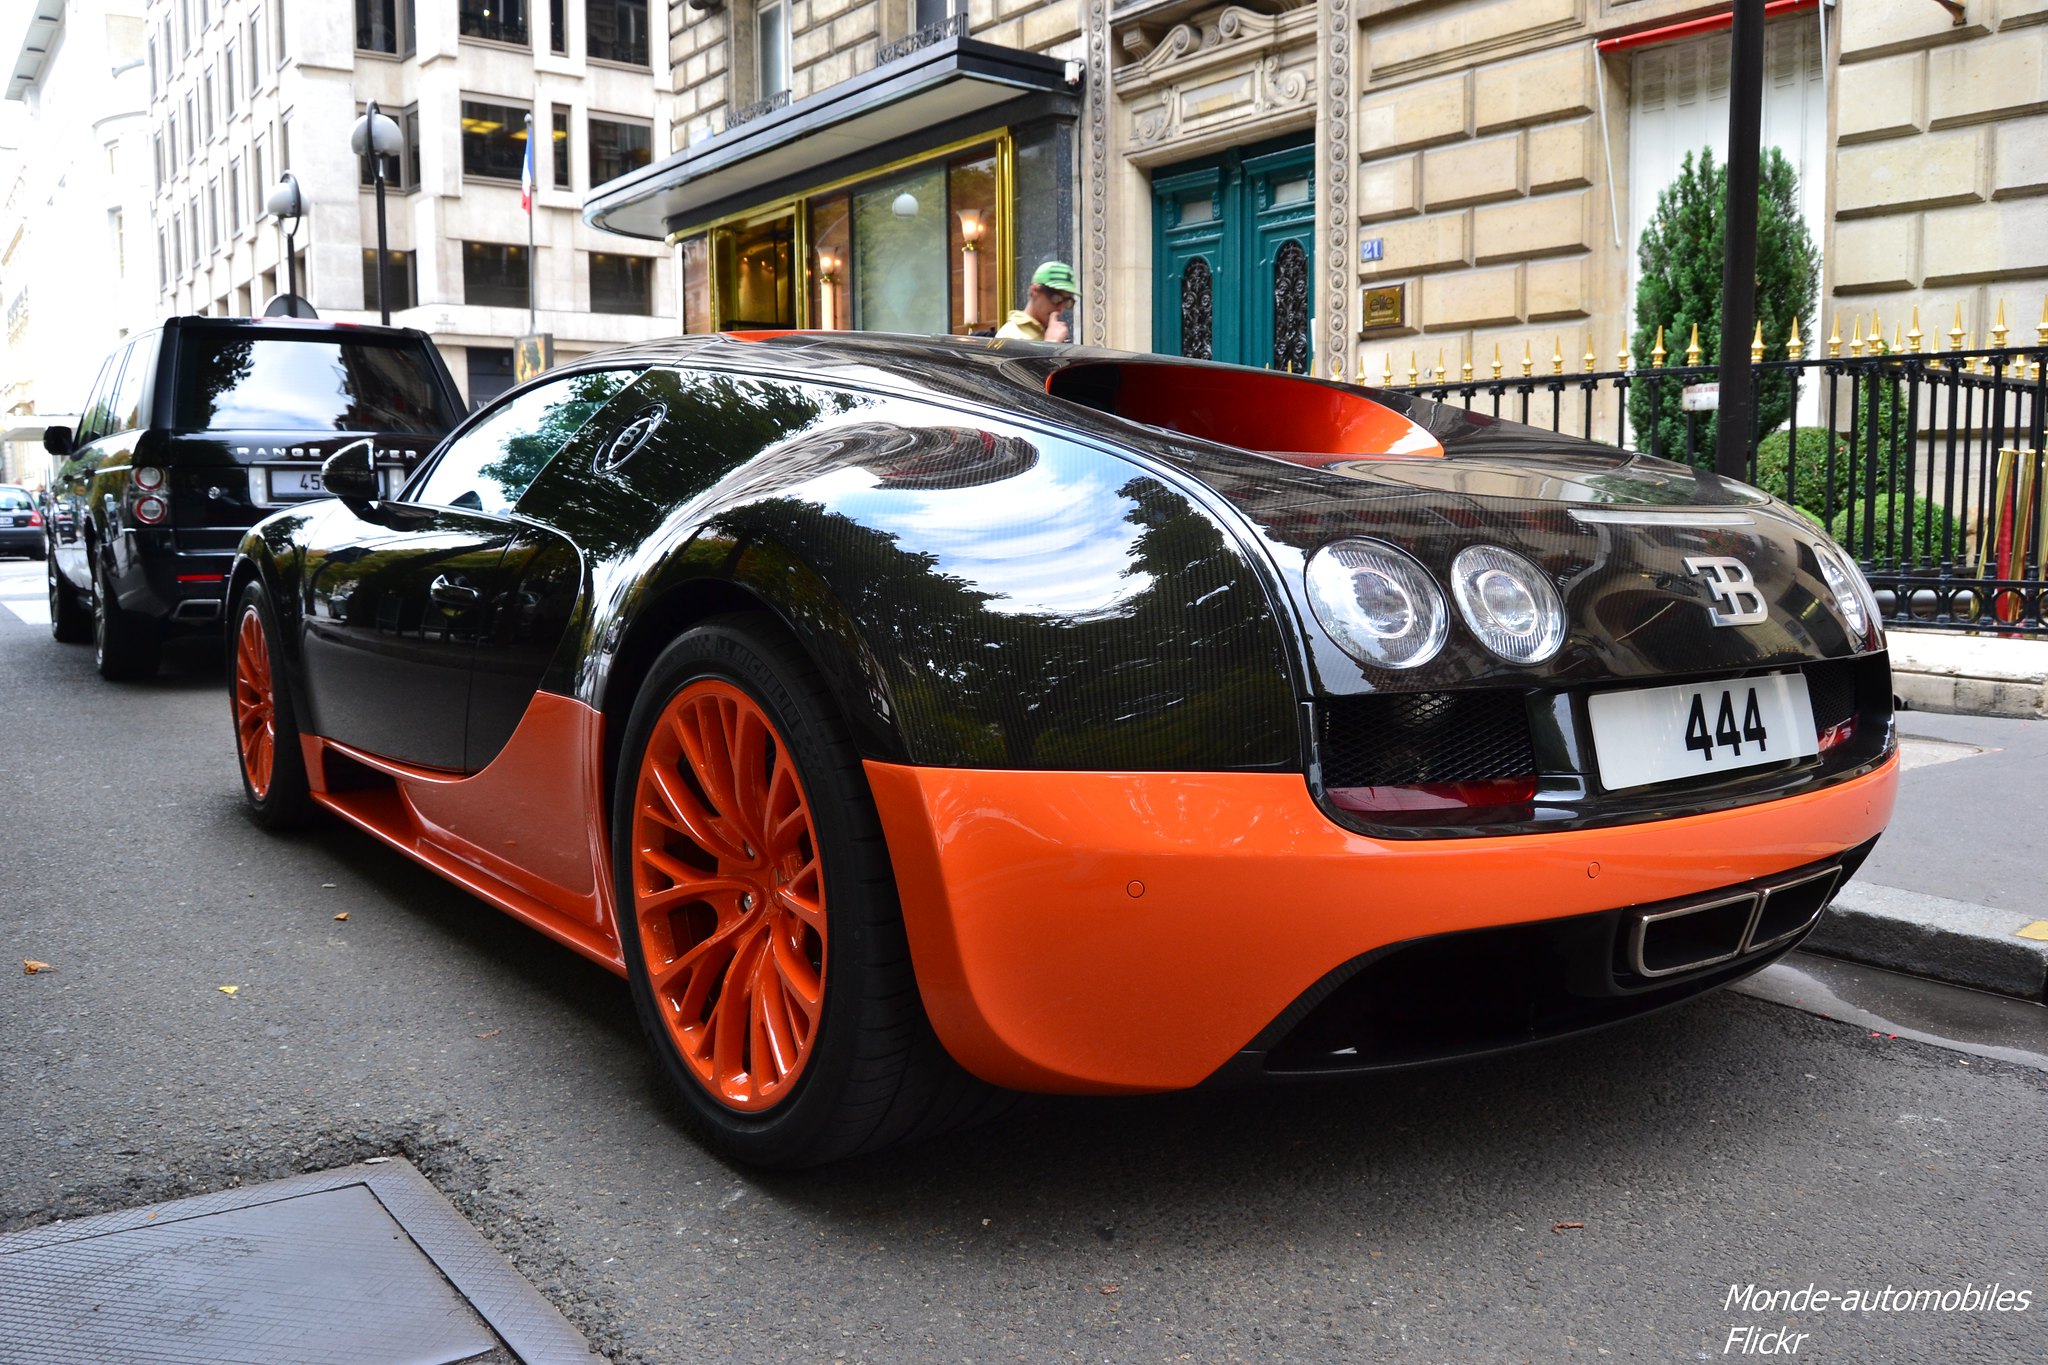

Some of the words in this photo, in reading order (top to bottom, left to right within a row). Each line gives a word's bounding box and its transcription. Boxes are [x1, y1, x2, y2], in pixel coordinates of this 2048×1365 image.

[1363, 240, 1380, 259] 21
[236, 447, 321, 457] RANGE
[300, 473, 325, 491] 45
[1685, 687, 1768, 762] 444
